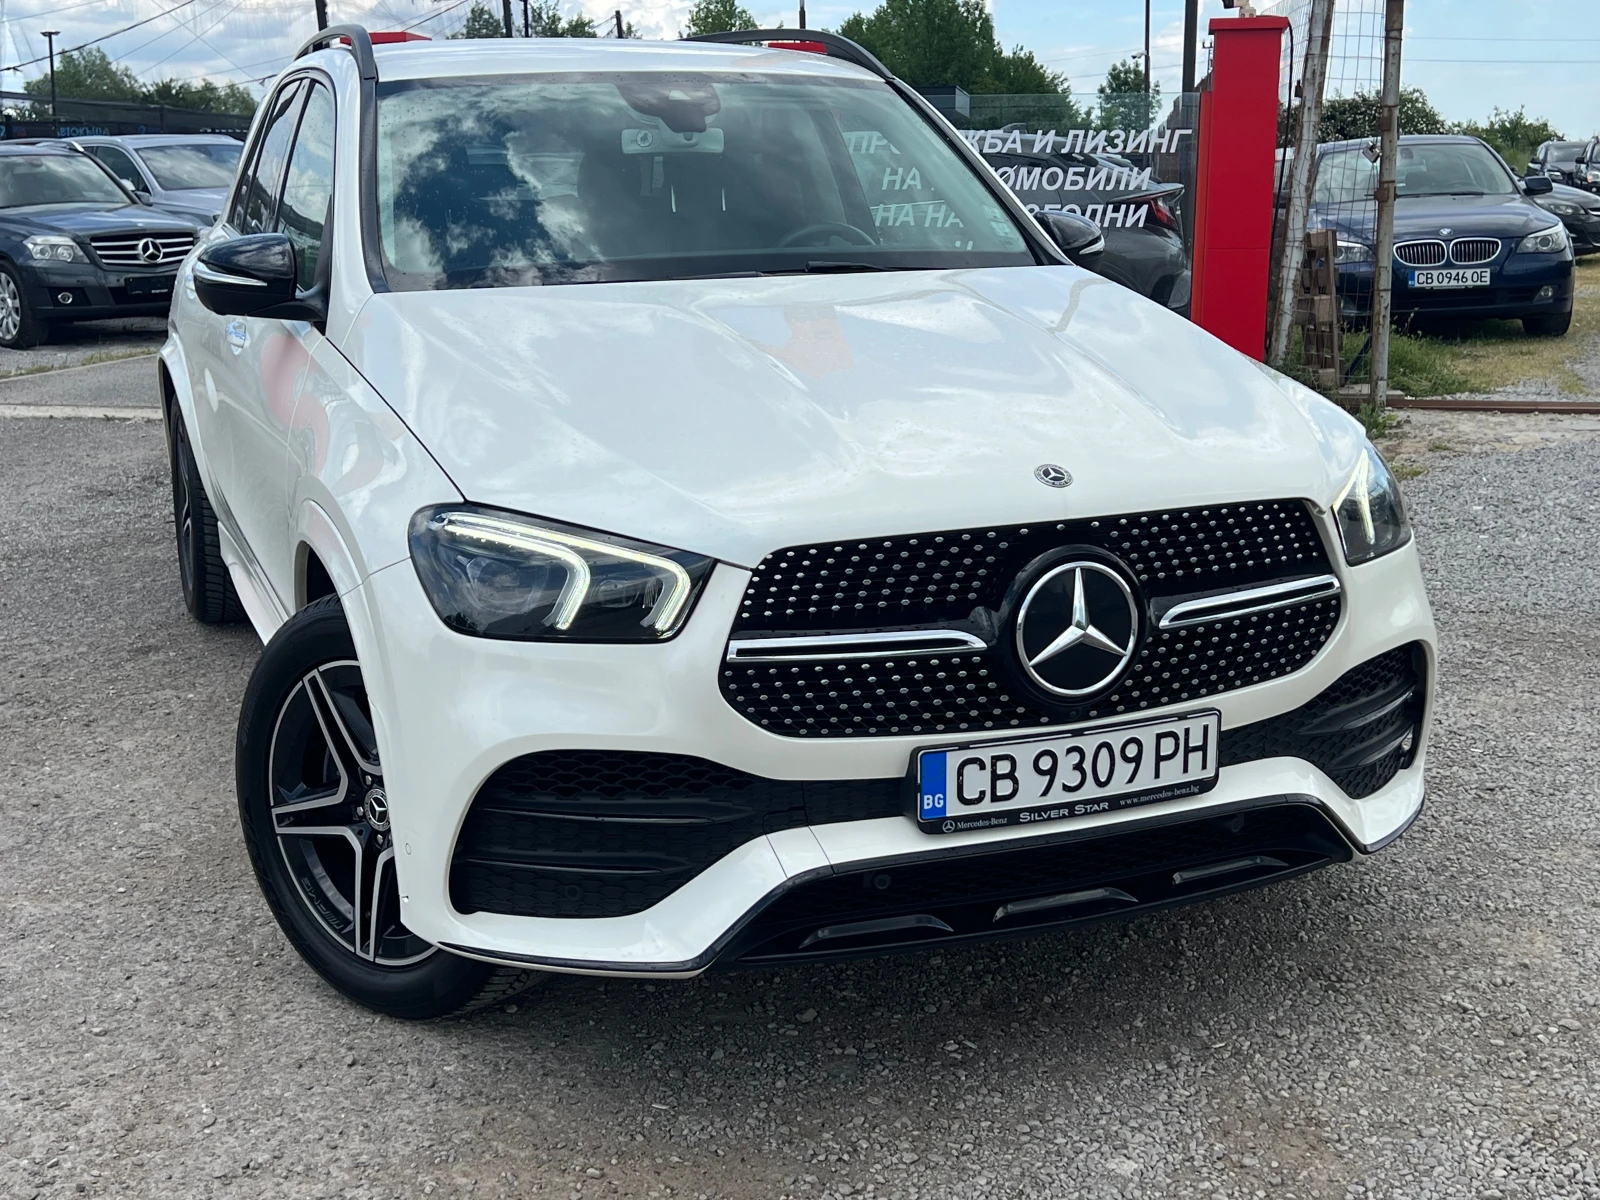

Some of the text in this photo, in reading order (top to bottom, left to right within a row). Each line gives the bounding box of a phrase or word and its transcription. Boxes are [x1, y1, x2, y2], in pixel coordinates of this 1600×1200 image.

[1032, 130, 1056, 154] И
[1060, 129, 1193, 154] ЛИЗИНГ
[881, 167, 922, 191] НА
[875, 204, 915, 227] НА
[1416, 272, 1434, 285] CB
[1436, 271, 1469, 285] 0946
[956, 723, 1210, 806] CB 9309 PH
[923, 793, 944, 809] BG
[1119, 784, 1200, 807] www.mercedes-benz.bg
[956, 817, 1008, 830] Mercedes-Benz
[1019, 801, 1110, 823] SILVER STAR
